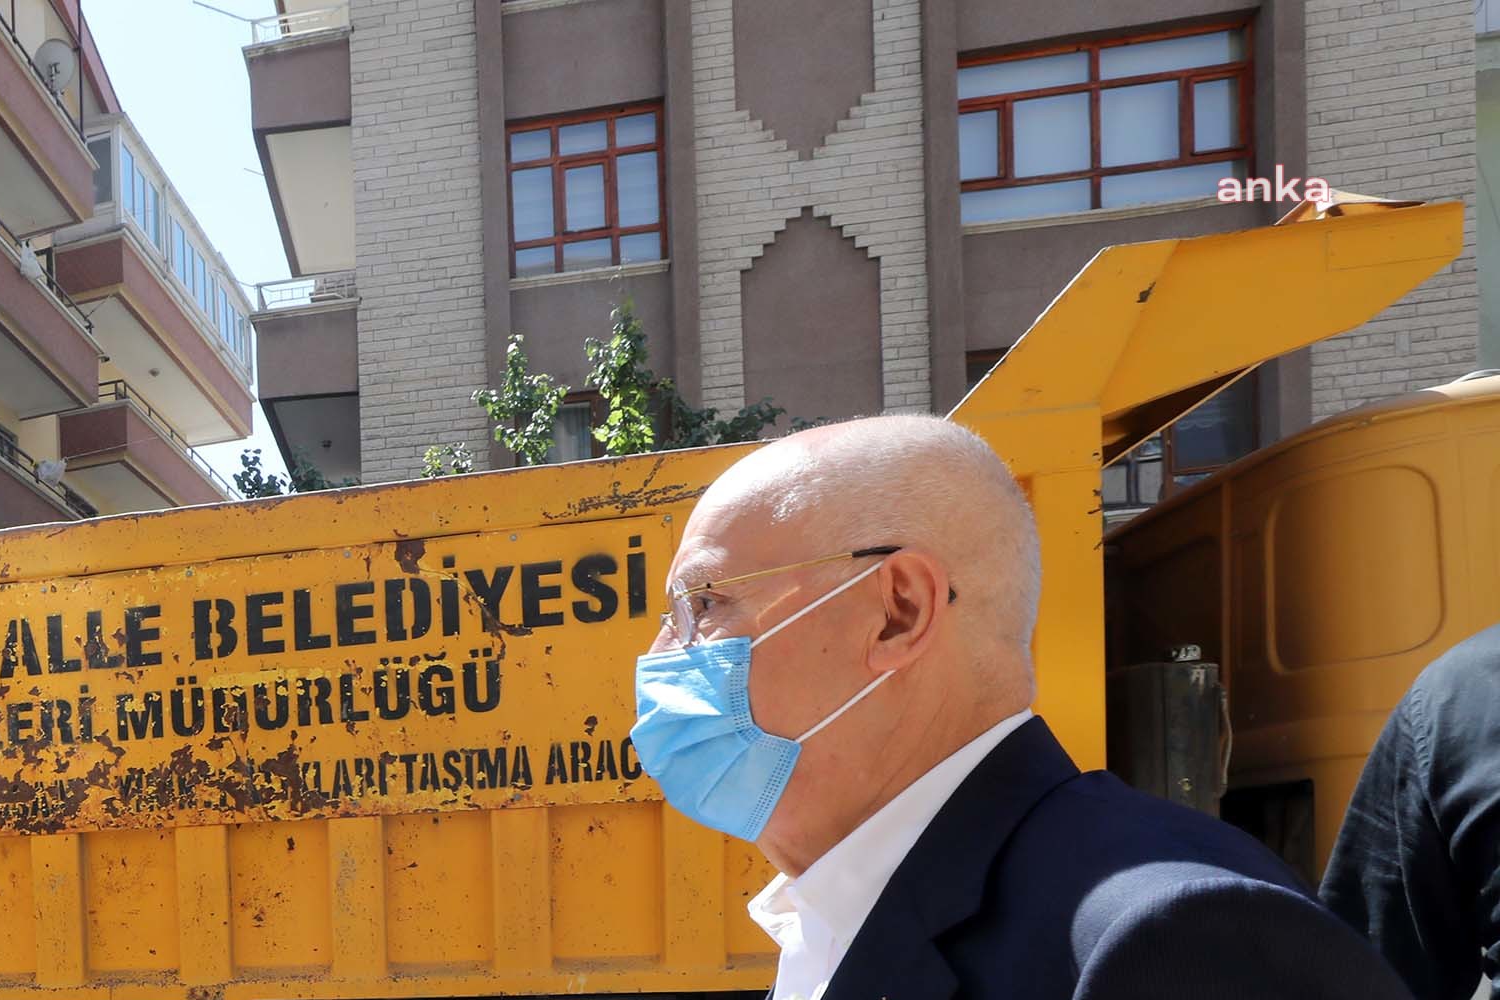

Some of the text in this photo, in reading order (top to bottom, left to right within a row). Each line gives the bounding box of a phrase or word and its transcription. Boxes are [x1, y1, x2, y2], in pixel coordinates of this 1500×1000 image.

[193, 536, 648, 662] BELEDİYESİ
[115, 647, 501, 742] MÜDÜRLÜĞÜ
[545, 737, 651, 786] ARAC
